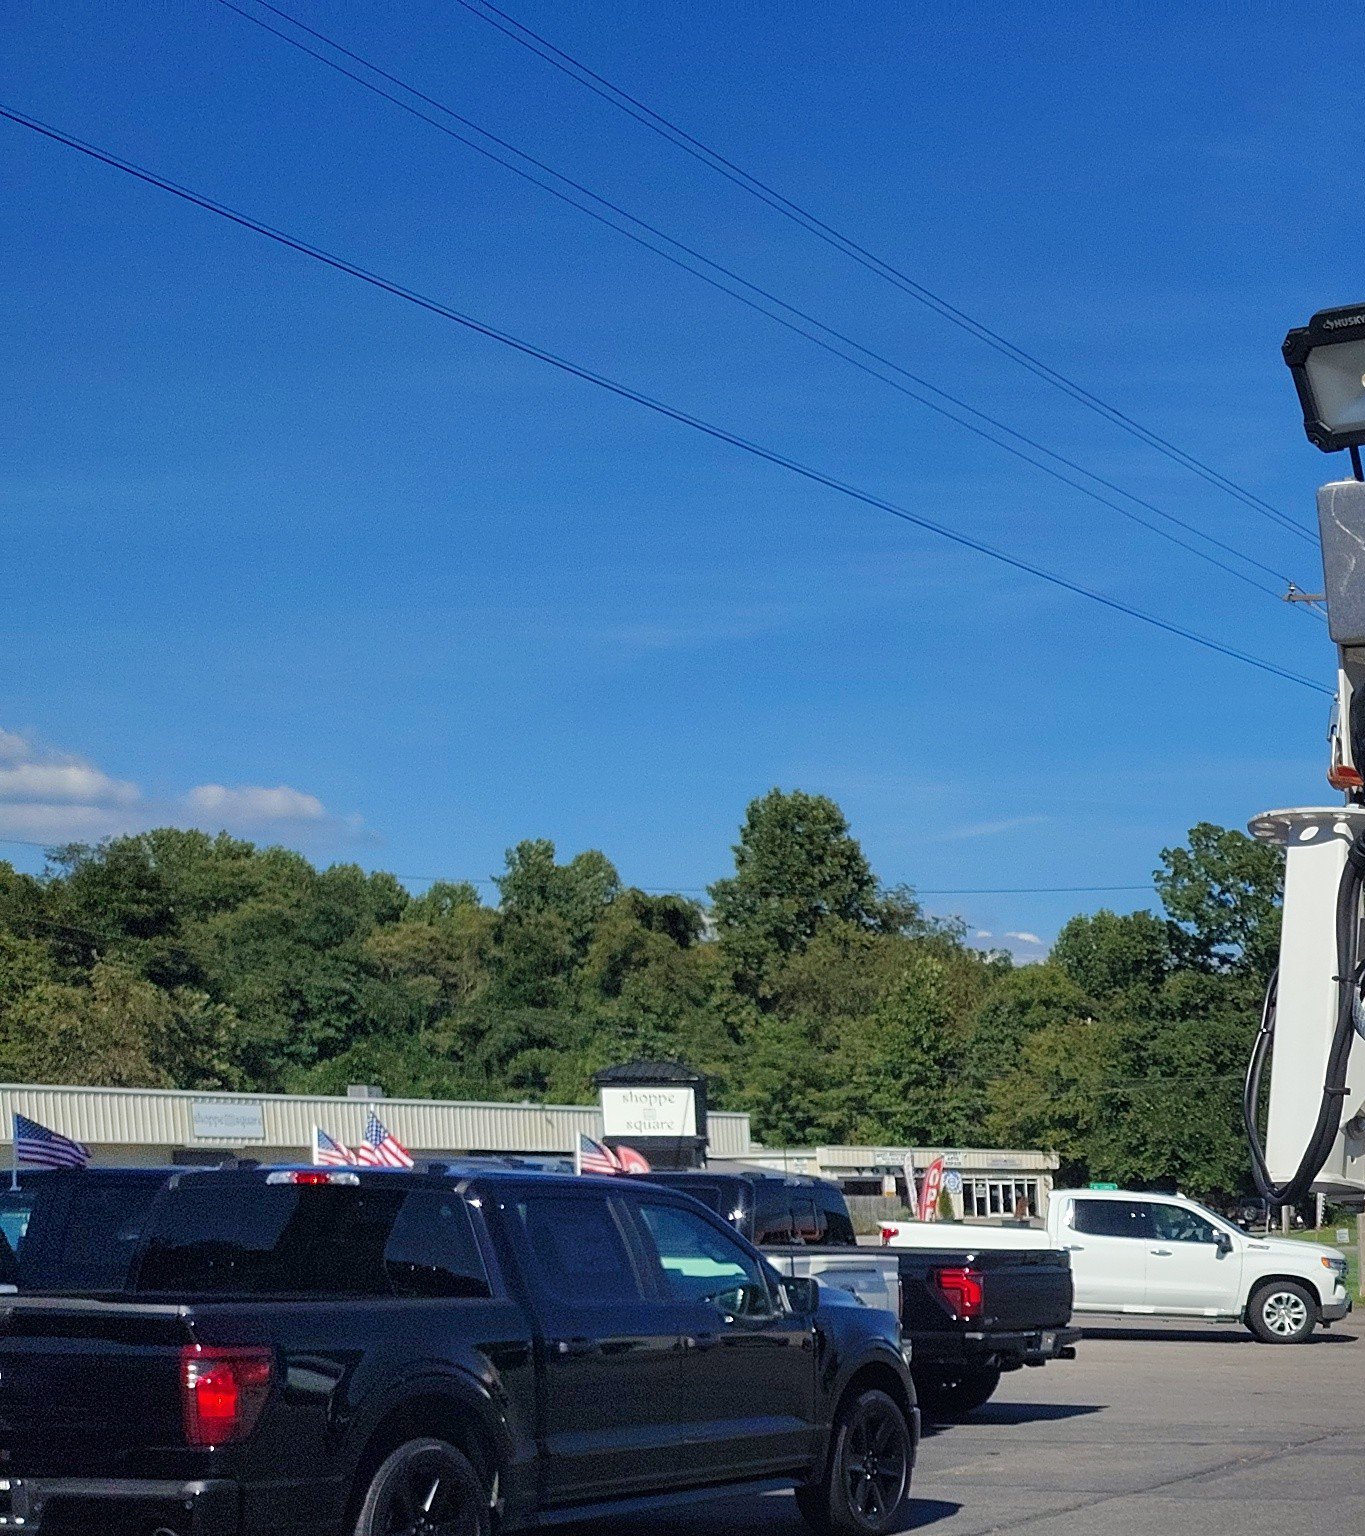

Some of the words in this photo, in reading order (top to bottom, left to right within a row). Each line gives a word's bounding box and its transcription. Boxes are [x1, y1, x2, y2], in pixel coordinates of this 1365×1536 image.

[1334, 314, 1365, 329] HUSKY
[622, 1091, 675, 1106] shoppe
[625, 1120, 675, 1134] square
